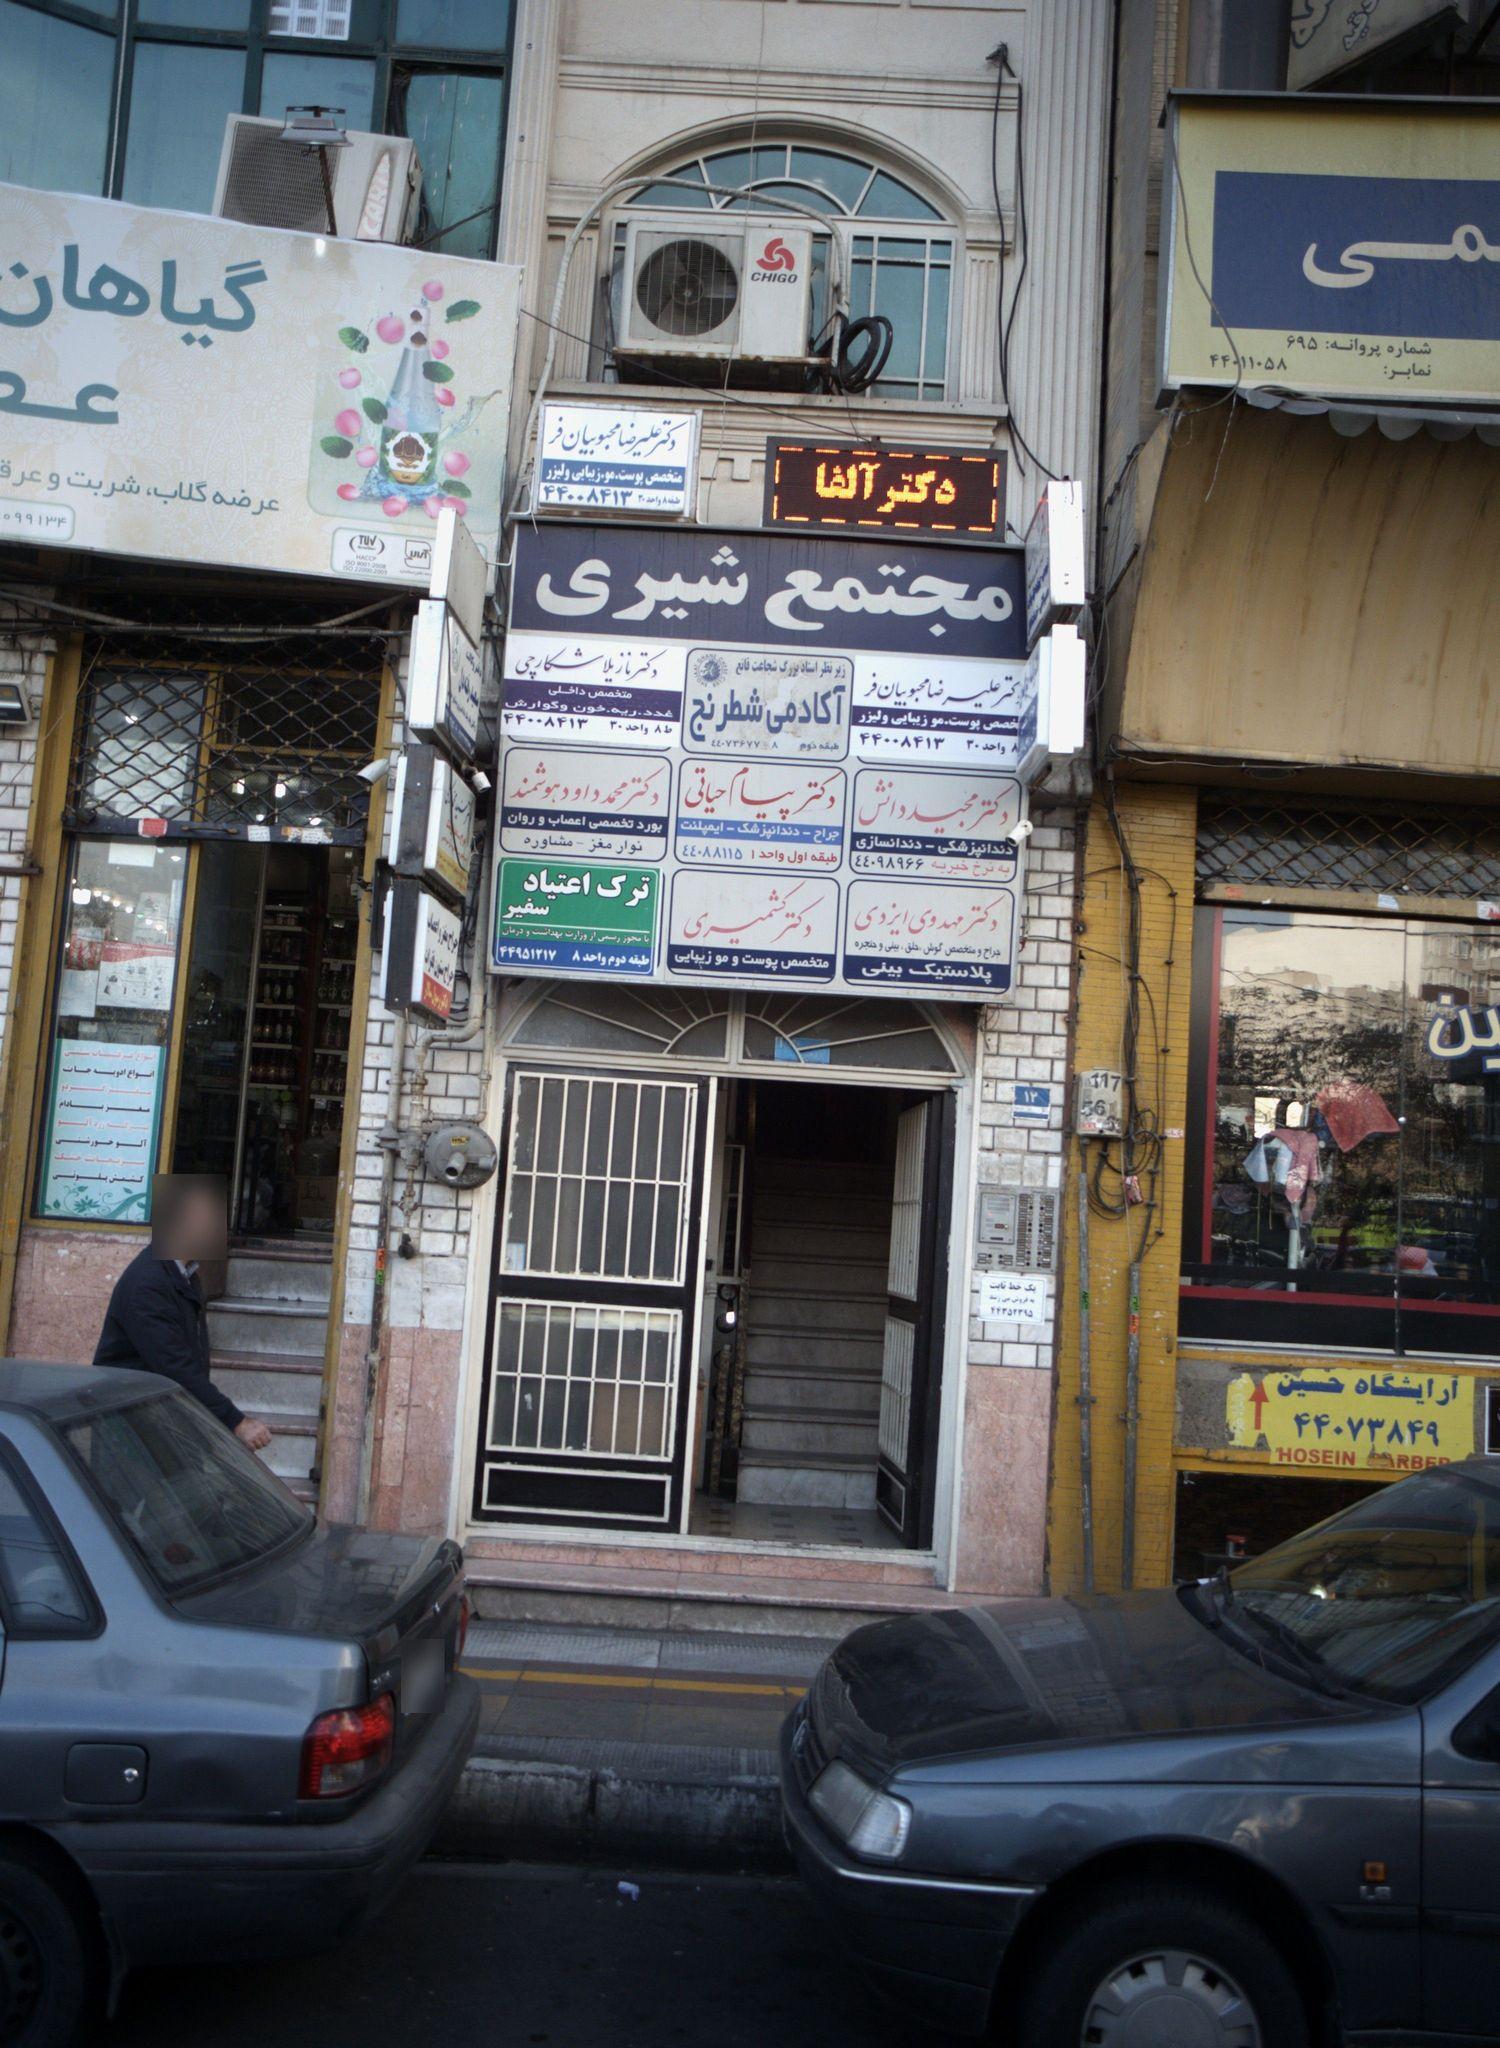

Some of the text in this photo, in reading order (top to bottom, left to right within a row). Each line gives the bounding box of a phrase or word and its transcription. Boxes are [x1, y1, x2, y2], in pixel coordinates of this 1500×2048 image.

[751, 271, 798, 285] CHIGO
[0, 244, 268, 350] گیاهان
[1387, 340, 1432, 358] شماره
[548, 416, 564, 445] فر
[618, 421, 662, 458] علیرضا
[644, 420, 688, 458] دکتر
[46, 471, 61, 491] و
[66, 471, 141, 498] شربت
[645, 469, 684, 486] متخصص
[543, 484, 634, 507] ۴۴۰۰۸۴۱۳
[814, 461, 957, 514] دکتر آلفا
[211, 487, 281, 516] عرضه
[535, 545, 749, 623] شیری
[763, 564, 1014, 638] مجتمع
[515, 647, 604, 680] شکارچی
[624, 648, 669, 682] دکتر
[751, 659, 777, 676] شجاعت
[819, 661, 833, 678] نظر
[548, 685, 633, 700] متخصص داخلی
[863, 672, 878, 697] فر
[990, 675, 1021, 708] کتر
[503, 713, 589, 731] ۴۴۰۰۸۴۱۳
[689, 685, 846, 742] آکادمی شطرنج
[891, 711, 928, 728] زیبایی
[609, 720, 623, 731] ۳۰
[625, 722, 649, 736] واحد
[800, 742, 817, 751] دوم
[818, 741, 840, 751] طبقه
[859, 732, 945, 751] ۴۴۰۰۸۴۱۳
[966, 739, 1006, 755] واحد ۳۰
[510, 761, 560, 803] هوشمند
[615, 766, 666, 812] دکتر
[684, 766, 842, 821] دکتر پیام حیاتی
[858, 778, 1016, 834] دکتر مجید دانش
[507, 811, 536, 826] روان
[548, 814, 586, 828] اعصاب
[588, 818, 634, 830] تخصصی
[637, 821, 663, 834] بورد
[680, 820, 840, 844] جراح دندانپزشک ایمپلنت
[523, 834, 643, 855] نوار مغز مشاوره
[855, 835, 1014, 857] دندانپزشکی دندانسازی
[758, 849, 785, 863] واحد
[787, 851, 807, 863] اول
[810, 852, 838, 866] طبقه
[523, 868, 592, 900] اعتیاد
[502, 897, 550, 919] سفیر
[683, 880, 825, 945] دکتر کشمیری
[854, 894, 1006, 936] دکتر مهدوی ایزدی
[532, 927, 563, 938] بهداشت
[565, 930, 588, 941] وزارت
[582, 951, 607, 966] واحد
[607, 954, 626, 967] دوم
[628, 954, 650, 967] طبقه
[674, 949, 713, 965] زیبایی
[715, 953, 729, 966] مو
[944, 946, 977, 957] متخصص
[742, 953, 780, 971] پوست
[780, 956, 830, 970] متخصص
[861, 961, 992, 985] پلاستیک بینی
[1023, 1090, 1039, 1103] ۱۲
[1277, 1372, 1459, 1406] آرایشگاه حسین
[1293, 1412, 1440, 1447] ۴۴۰۷۳۸۴۹
[1277, 1446, 1356, 1467] HOSEIN
